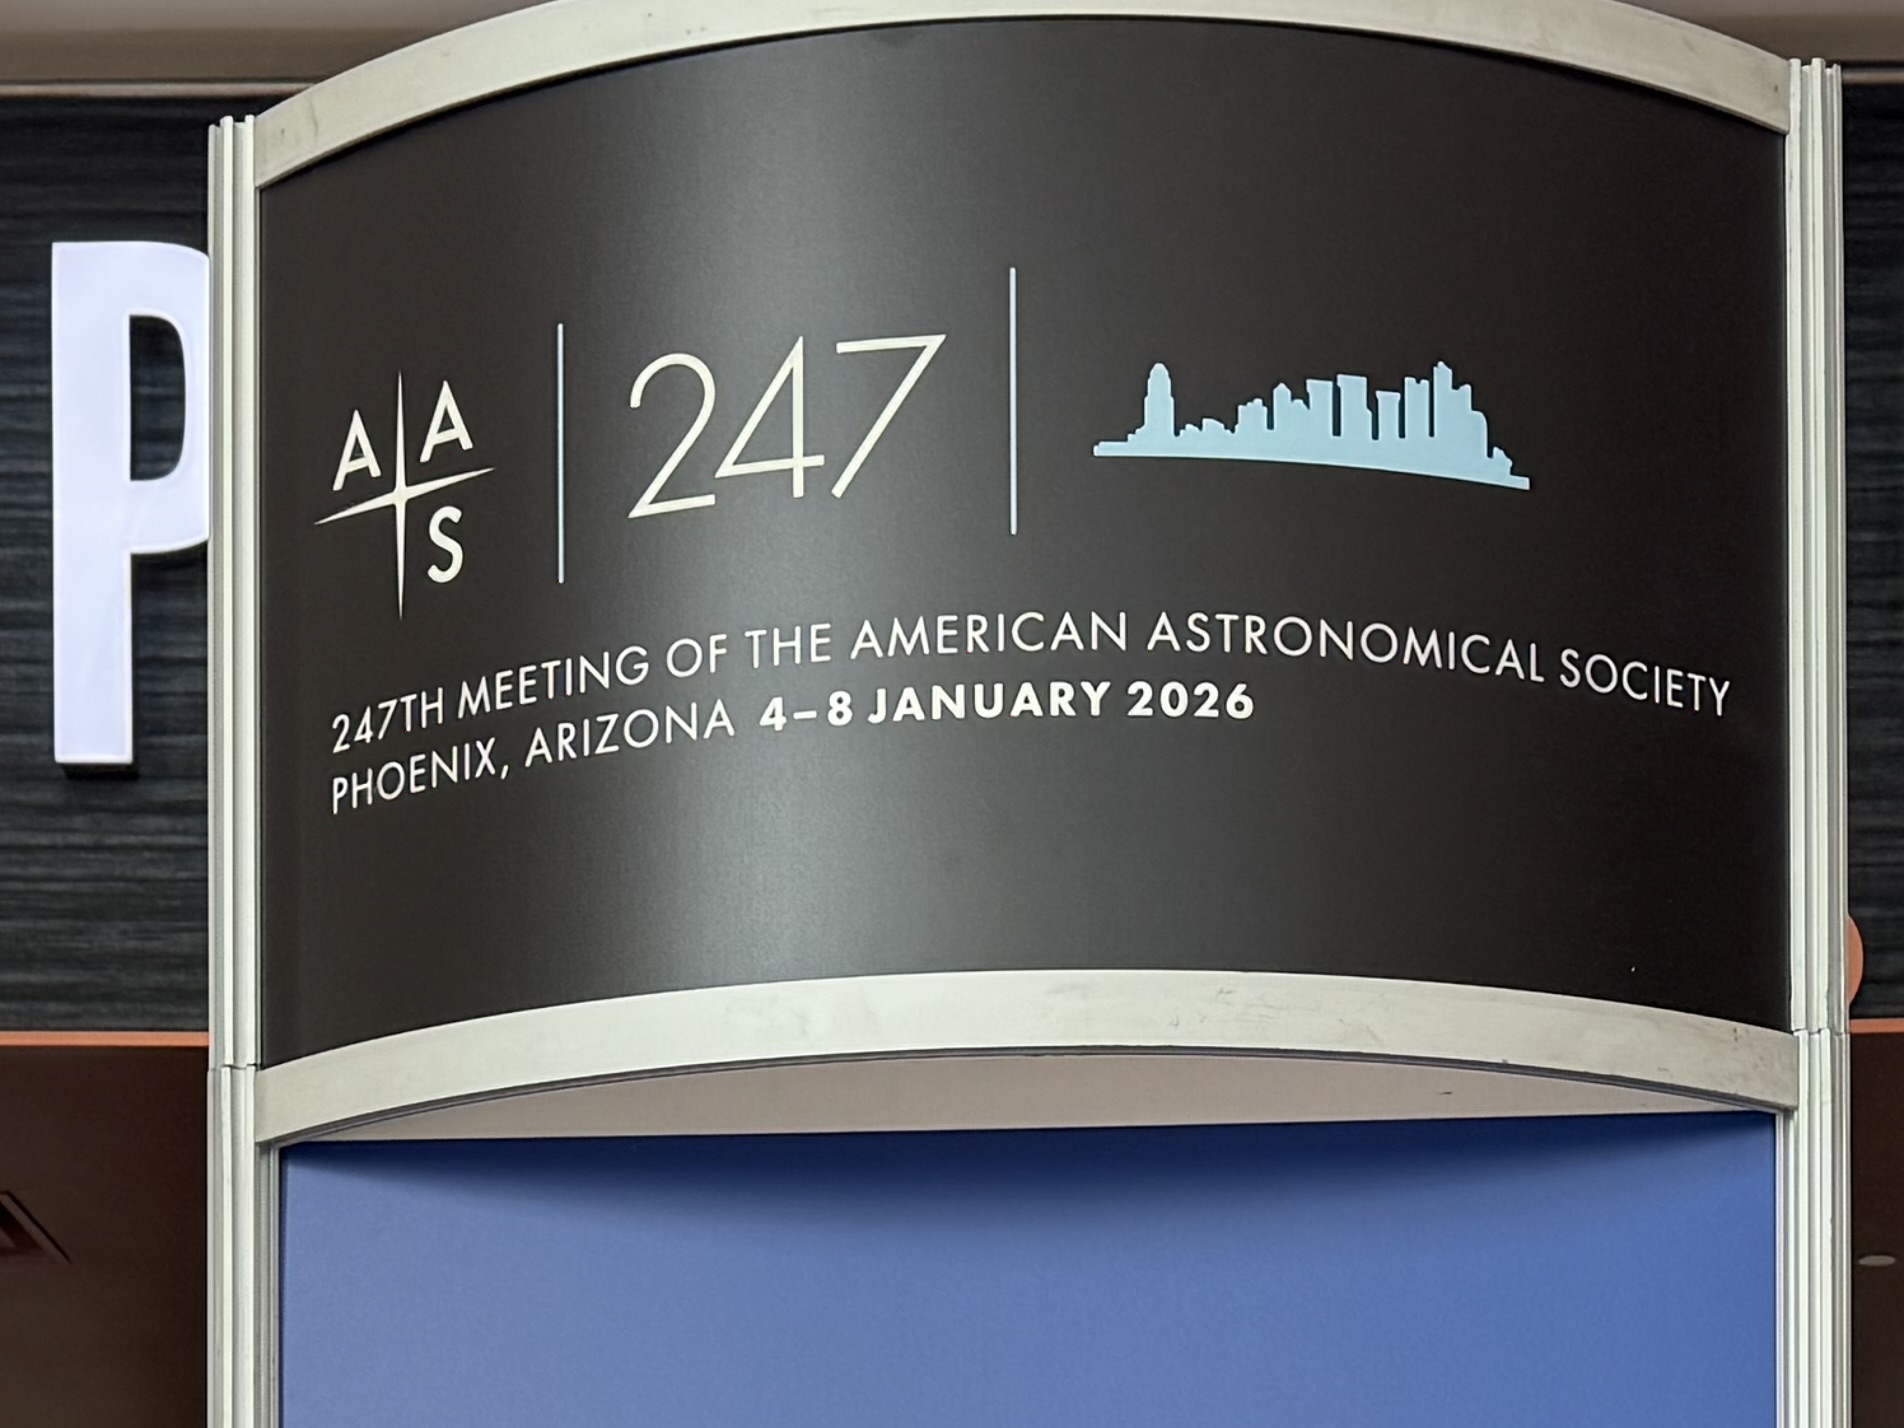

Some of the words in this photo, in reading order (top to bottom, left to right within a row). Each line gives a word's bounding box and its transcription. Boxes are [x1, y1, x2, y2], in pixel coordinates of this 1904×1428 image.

[629, 335, 945, 518] 247
[333, 688, 443, 753] 247TH
[459, 652, 649, 720] MEETING
[667, 634, 727, 677] OF
[745, 624, 830, 668] THE
[851, 612, 1125, 659] AMERICAN
[1148, 612, 1544, 681] ASTRONOMICAL
[1560, 649, 1729, 716] SOCIETY
[333, 750, 508, 814] PHOENIX,
[526, 701, 735, 767] ARIZONA
[868, 682, 1110, 723] JANUARY
[1128, 681, 1253, 718] 2026
